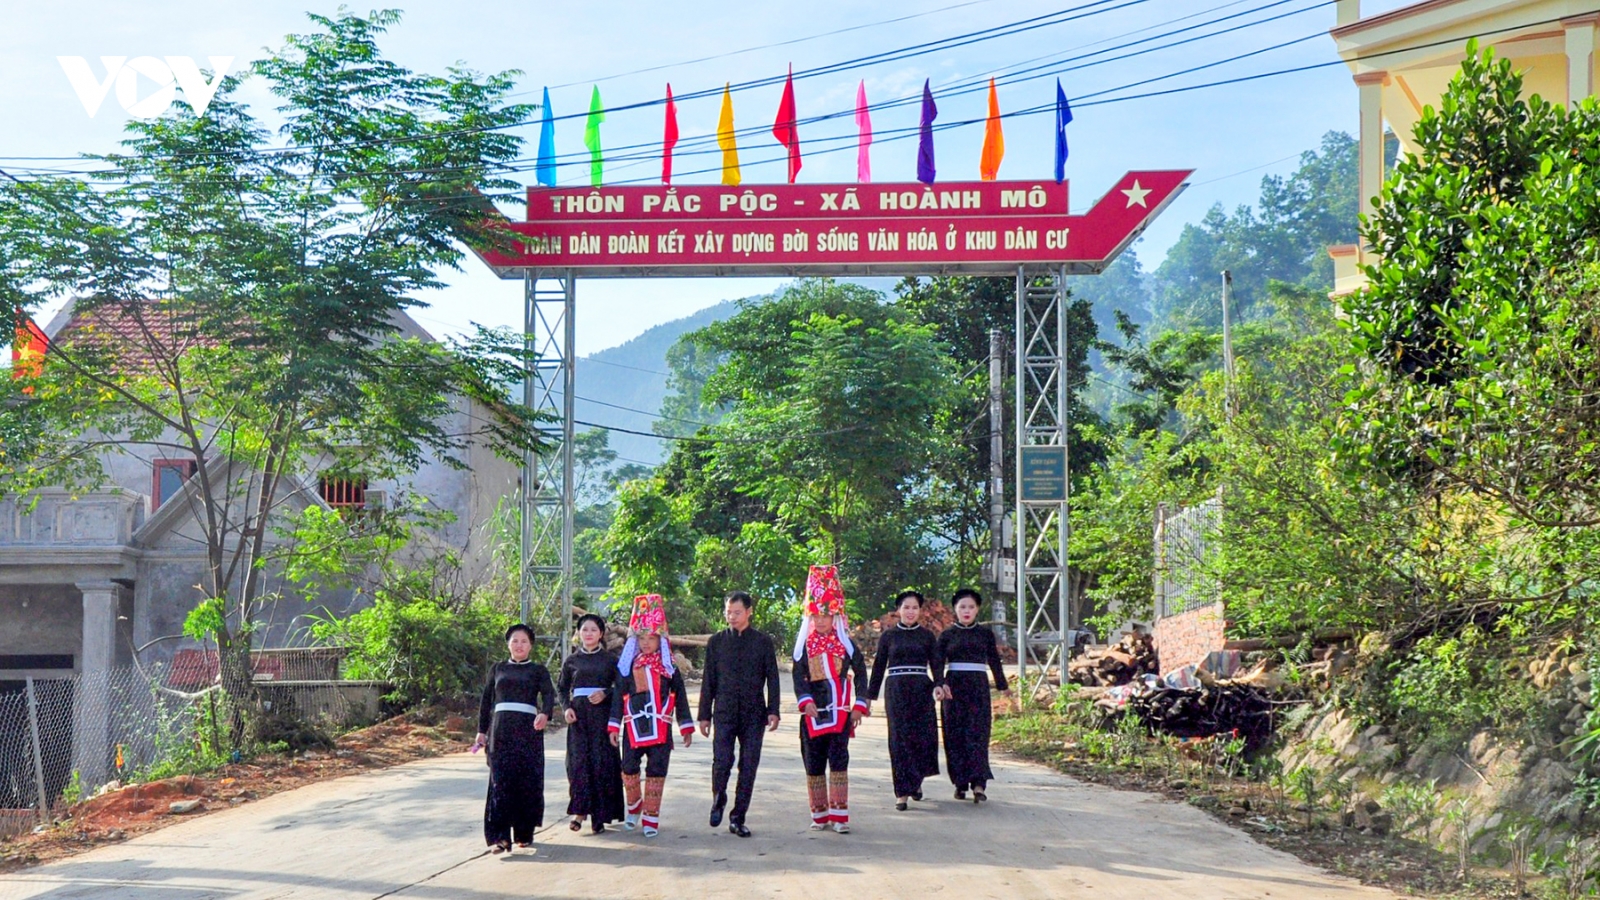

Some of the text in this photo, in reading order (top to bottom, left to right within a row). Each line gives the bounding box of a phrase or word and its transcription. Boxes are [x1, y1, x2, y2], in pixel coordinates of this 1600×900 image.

[550, 191, 625, 213] THÔN
[643, 187, 701, 212] PẮC
[720, 190, 778, 216] PỘC
[820, 187, 861, 211] XÃ
[879, 186, 981, 210] HOÀNH
[1000, 185, 1047, 208] MÔ
[569, 231, 600, 254] DÂN
[608, 230, 649, 254] ĐOÀN
[657, 228, 686, 253] KẾT
[694, 230, 724, 253] XÂY
[732, 231, 775, 257] DỰNG
[782, 228, 809, 252] ĐỜI
[817, 226, 859, 252] SỐNG
[868, 227, 899, 251] VĂN
[907, 227, 938, 251] HÓA
[945, 223, 957, 251] Ở
[965, 230, 997, 250] KHU
[1004, 226, 1037, 250] DÂN
[1046, 227, 1070, 250] CƯ
